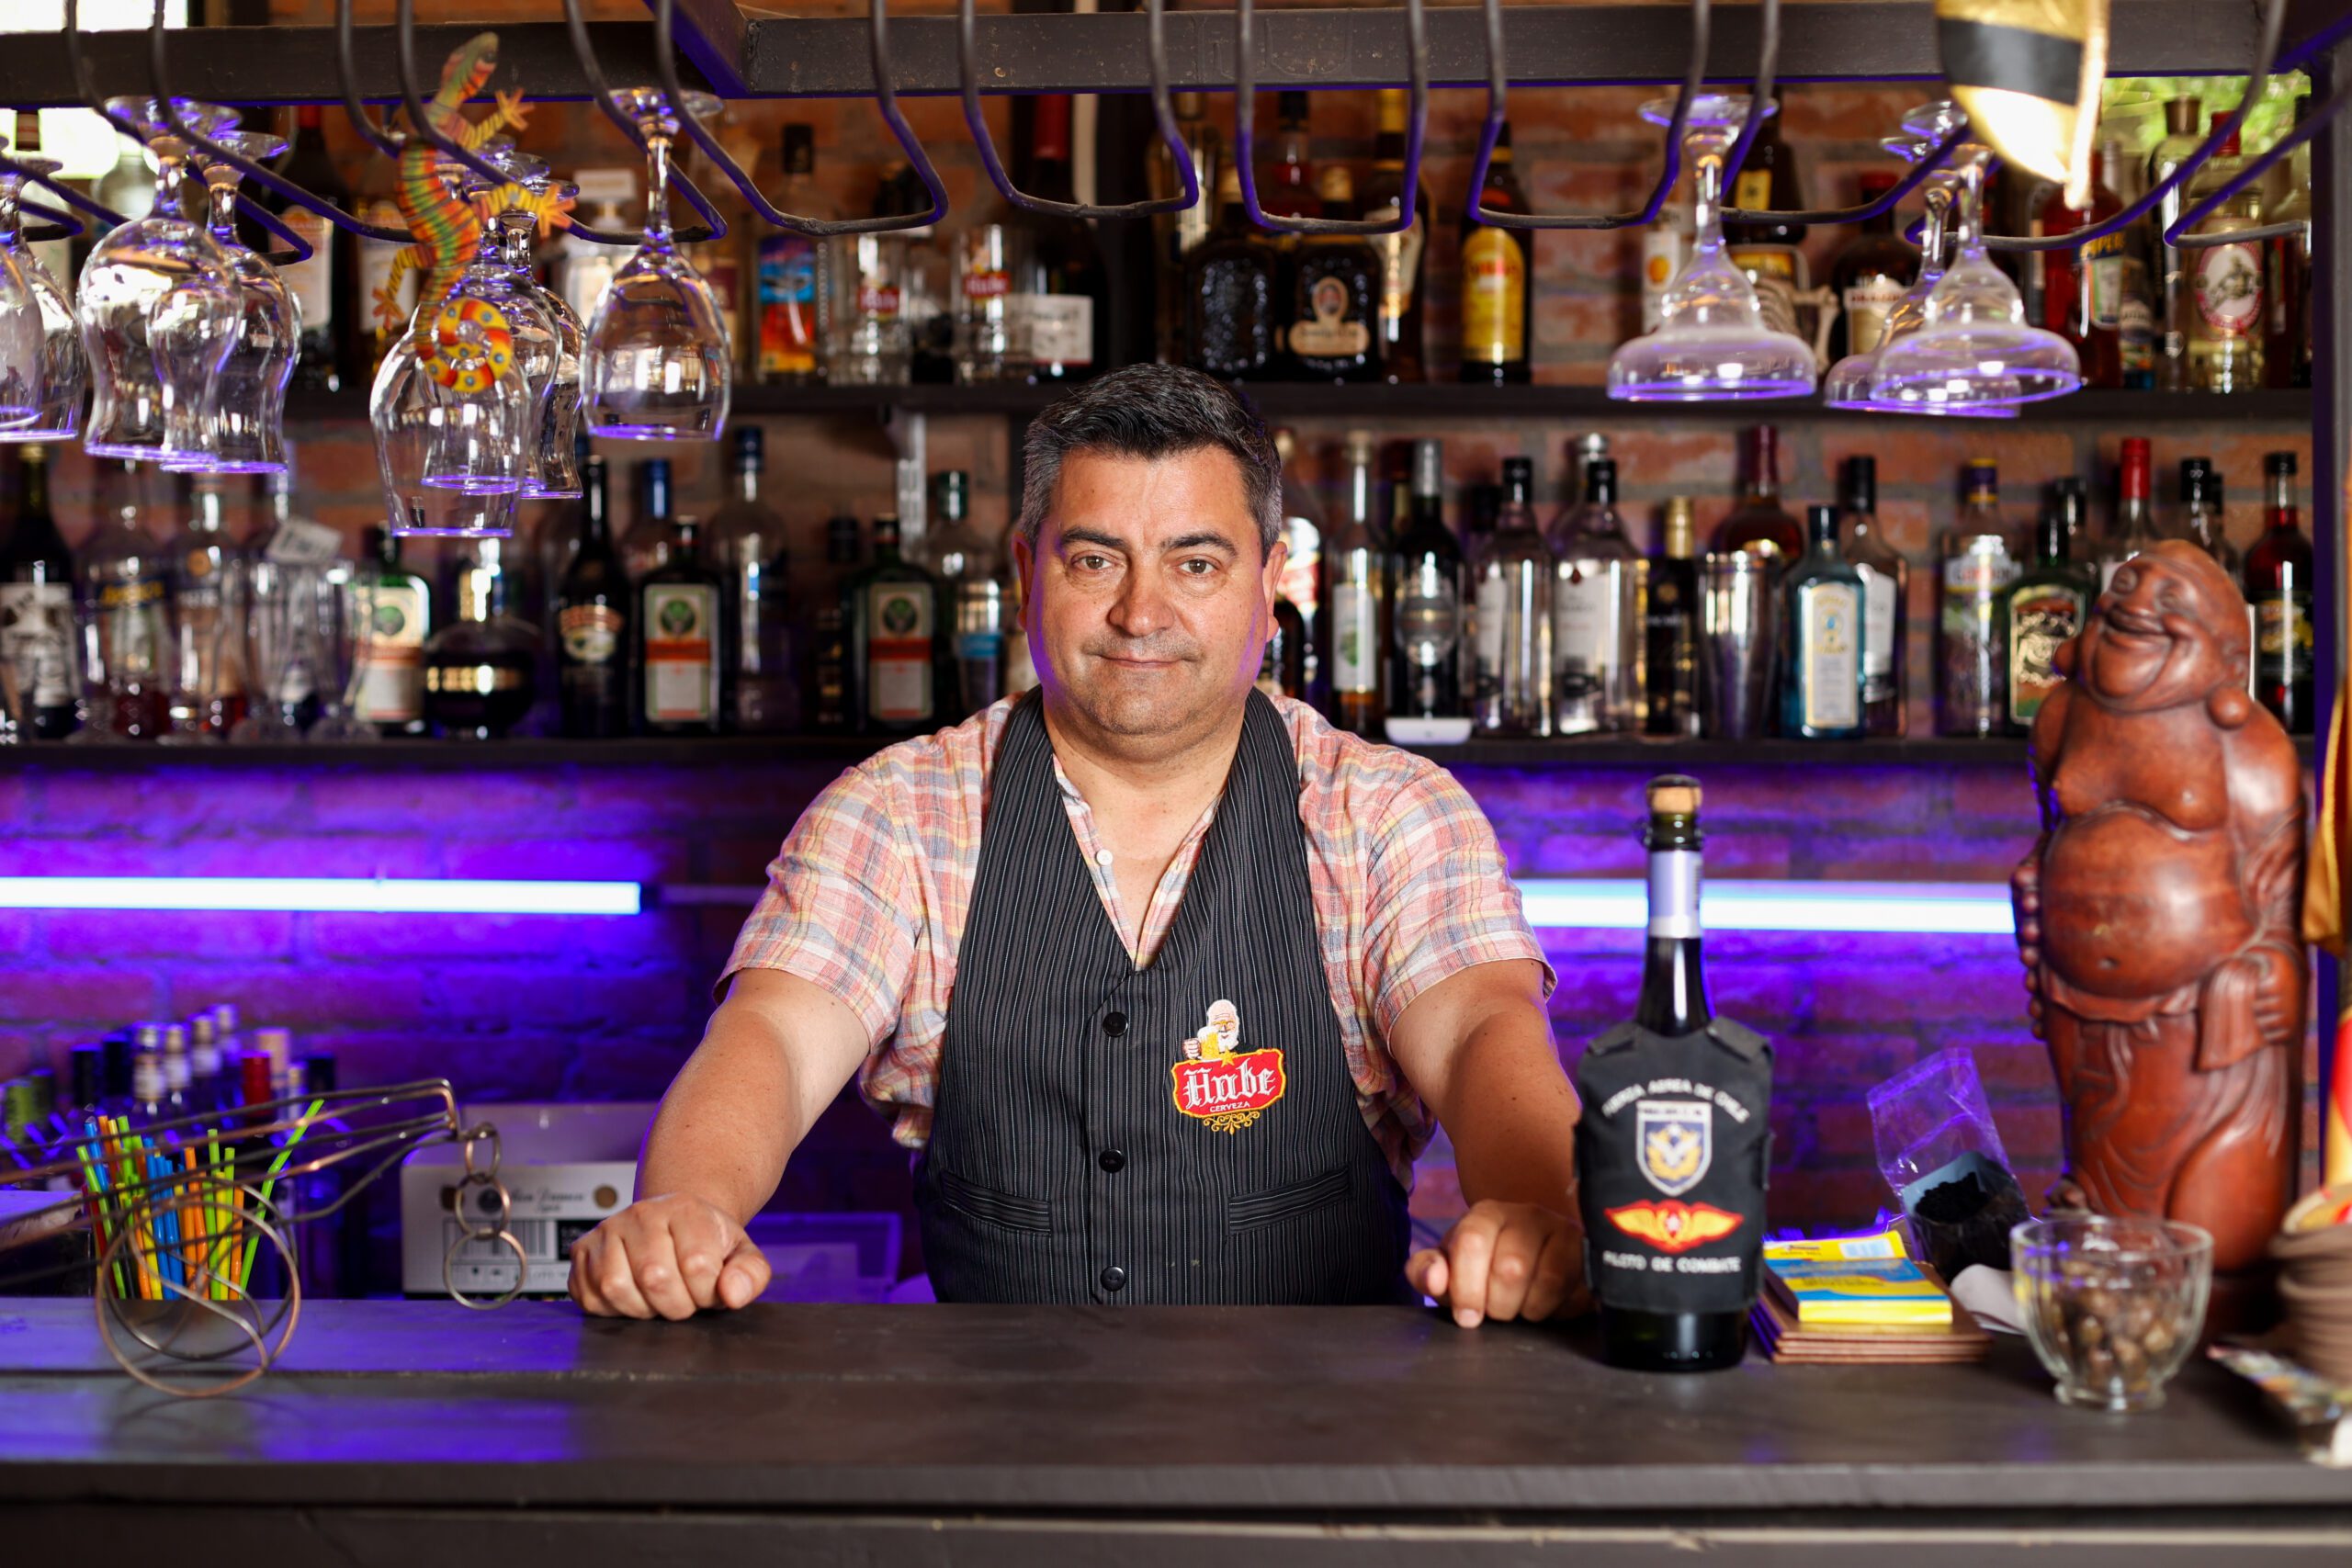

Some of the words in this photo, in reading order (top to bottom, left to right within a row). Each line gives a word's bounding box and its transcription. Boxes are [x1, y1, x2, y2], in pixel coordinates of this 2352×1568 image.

[1210, 1100, 1250, 1112] CERVEZA
[1694, 1082, 1715, 1100] DE
[1714, 1090, 1750, 1123] CHILE
[1602, 1250, 1646, 1270] PILOTO
[1651, 1256, 1673, 1272] DE
[1677, 1256, 1741, 1273] COMBATE
